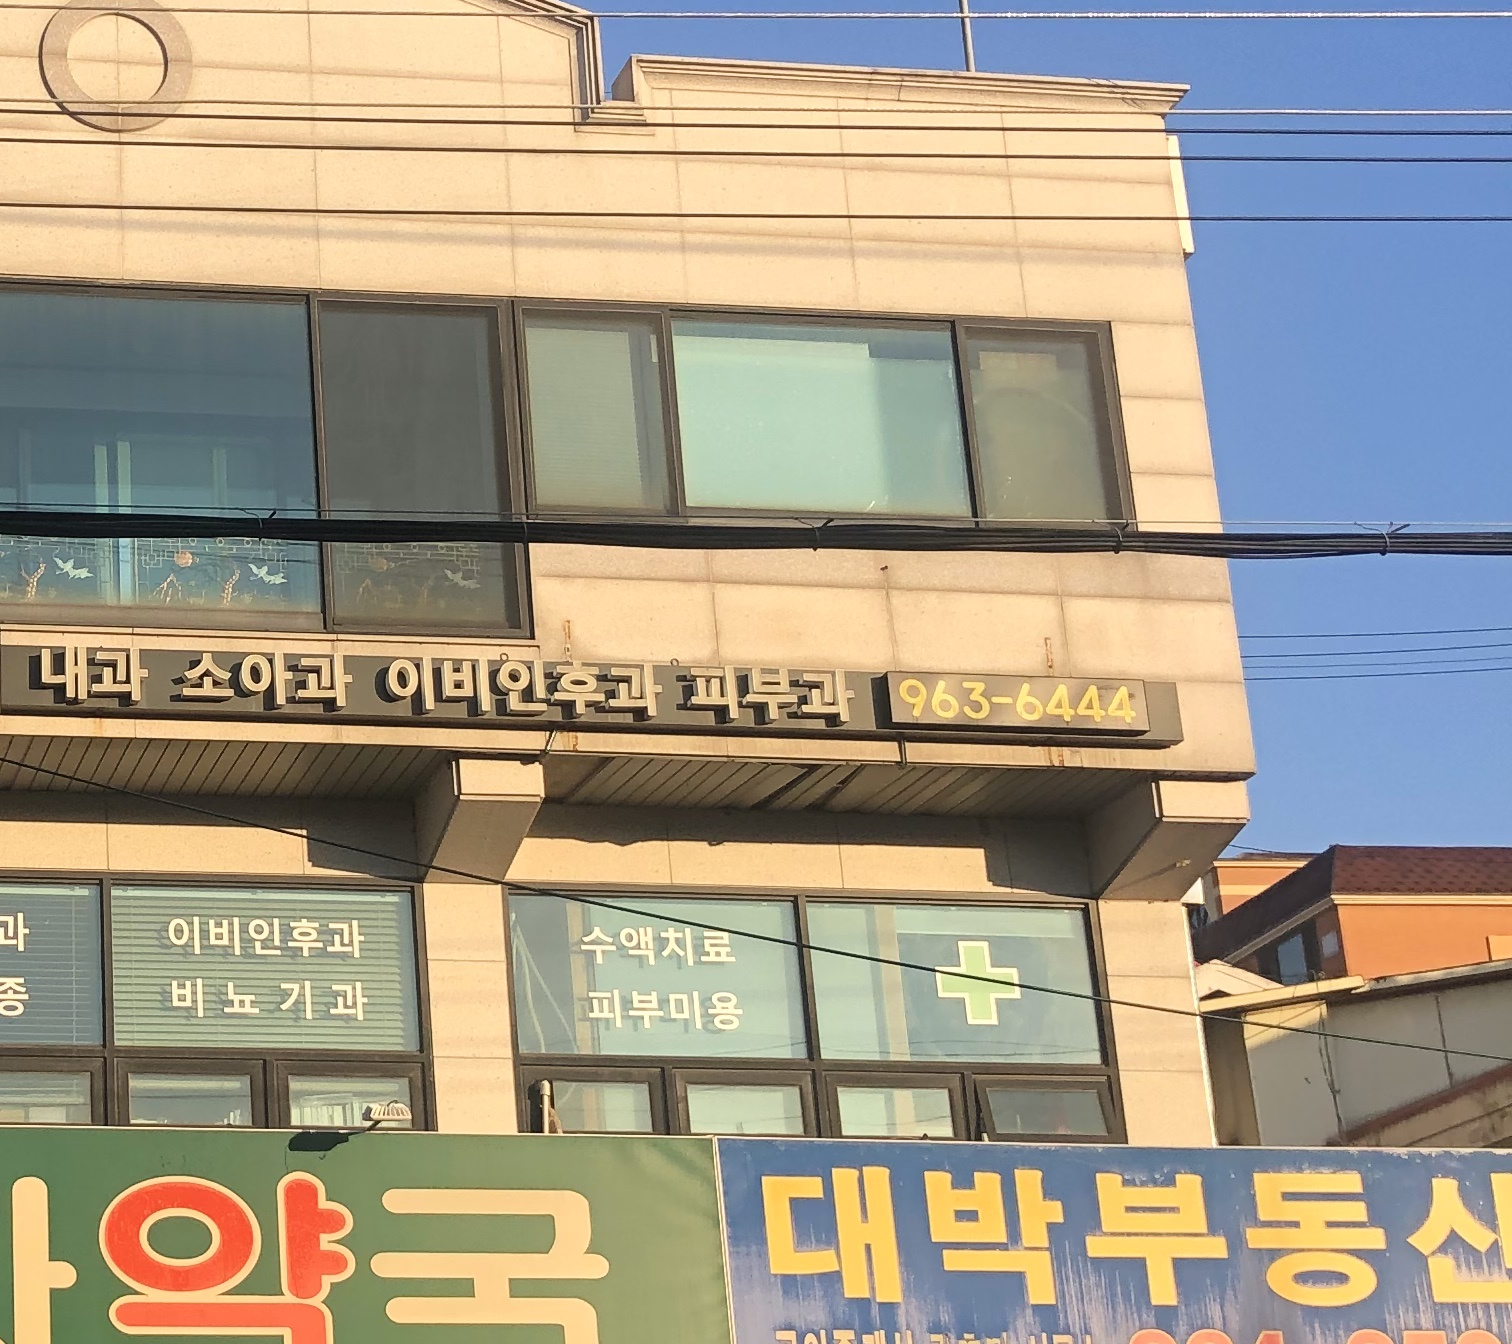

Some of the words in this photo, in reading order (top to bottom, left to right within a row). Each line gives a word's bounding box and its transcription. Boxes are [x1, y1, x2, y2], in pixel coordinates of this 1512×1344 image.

[40, 647, 149, 704] 내과
[183, 650, 353, 709] 소아과
[387, 656, 663, 719] 이비인후과
[687, 665, 855, 726] 피부과
[898, 679, 1138, 724] 963-6444
[168, 916, 365, 959] 이비인후과
[580, 926, 737, 968] 수액치료
[587, 989, 745, 1032] 피부미용
[761, 1164, 1512, 1308] 대박부동산
